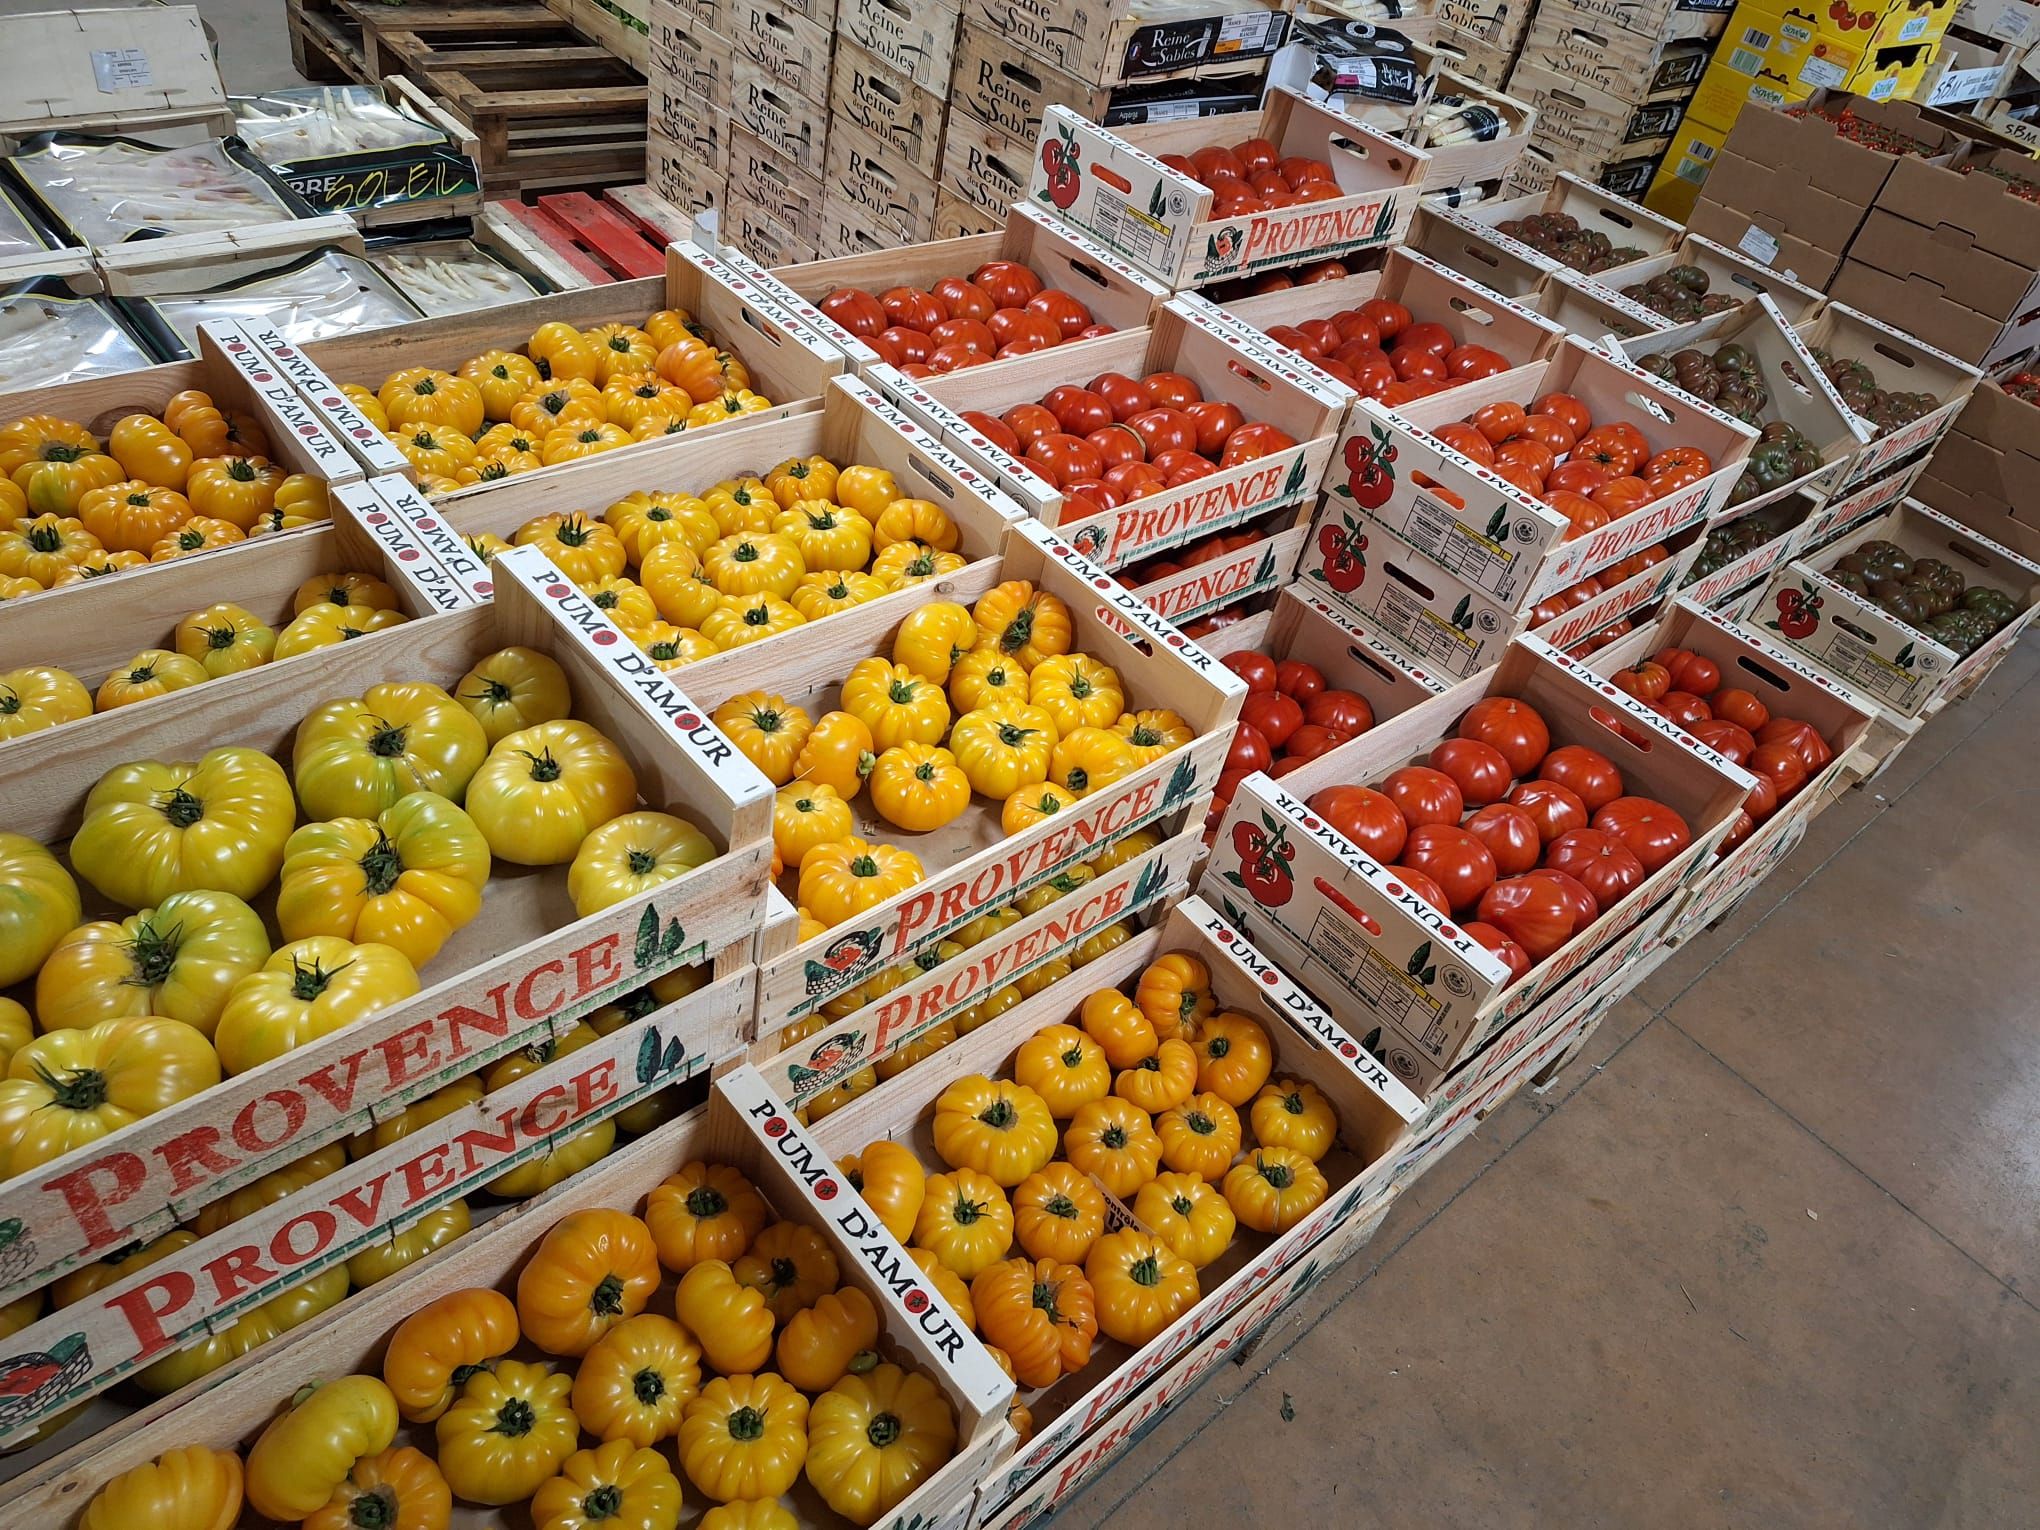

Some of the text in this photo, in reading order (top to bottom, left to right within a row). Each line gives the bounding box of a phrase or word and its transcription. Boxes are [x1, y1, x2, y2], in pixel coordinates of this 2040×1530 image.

[750, 9, 788, 56] Reine
[858, 0, 904, 40] Reine
[1007, 0, 1050, 22] eine
[1007, 7, 1064, 57] Sables
[1441, 3, 1487, 36] Sables
[662, 26, 696, 67] Reine
[868, 26, 915, 72] Sables
[1151, 29, 1191, 48] Reine
[1156, 48, 1196, 65] Sables
[1556, 28, 1604, 62] Reine
[671, 56, 709, 96] Sables
[758, 41, 799, 88] Sables
[977, 58, 1032, 114] Reine
[1560, 54, 1611, 86] Sables
[663, 92, 697, 134] Reine
[750, 83, 787, 129] Reine
[851, 70, 896, 121] Reine
[671, 122, 709, 160] Sables
[758, 115, 798, 158] Sables
[862, 106, 907, 151] Sables
[1535, 113, 1586, 147] Sables
[290, 177, 337, 195] RRE
[325, 161, 464, 211] SOLEIL
[661, 156, 694, 197] Reine
[749, 155, 786, 201] Reine
[849, 150, 893, 200] Reine
[967, 145, 1018, 200] Reine
[669, 186, 699, 214] Sable
[757, 186, 797, 229] Sables
[858, 183, 901, 224] Sabl
[977, 183, 1008, 218] Sab
[742, 218, 778, 264] Reine
[839, 223, 864, 254] Rei
[1238, 203, 1381, 270] PROVENCE
[1104, 465, 1284, 565] PROVENCE
[1571, 489, 1705, 580] PROVENCE
[413, 566, 461, 610] D'AM
[1142, 557, 1256, 618] OVENCE
[886, 777, 1160, 963] PROVENCE
[866, 880, 1129, 1060] PROVENCE
[43, 933, 621, 1256] PROVENCE
[104, 1058, 618, 1363] PROVENCE
[1080, 1211, 1332, 1432] PROVENCE
[1052, 1282, 1290, 1502] PROVENCE
